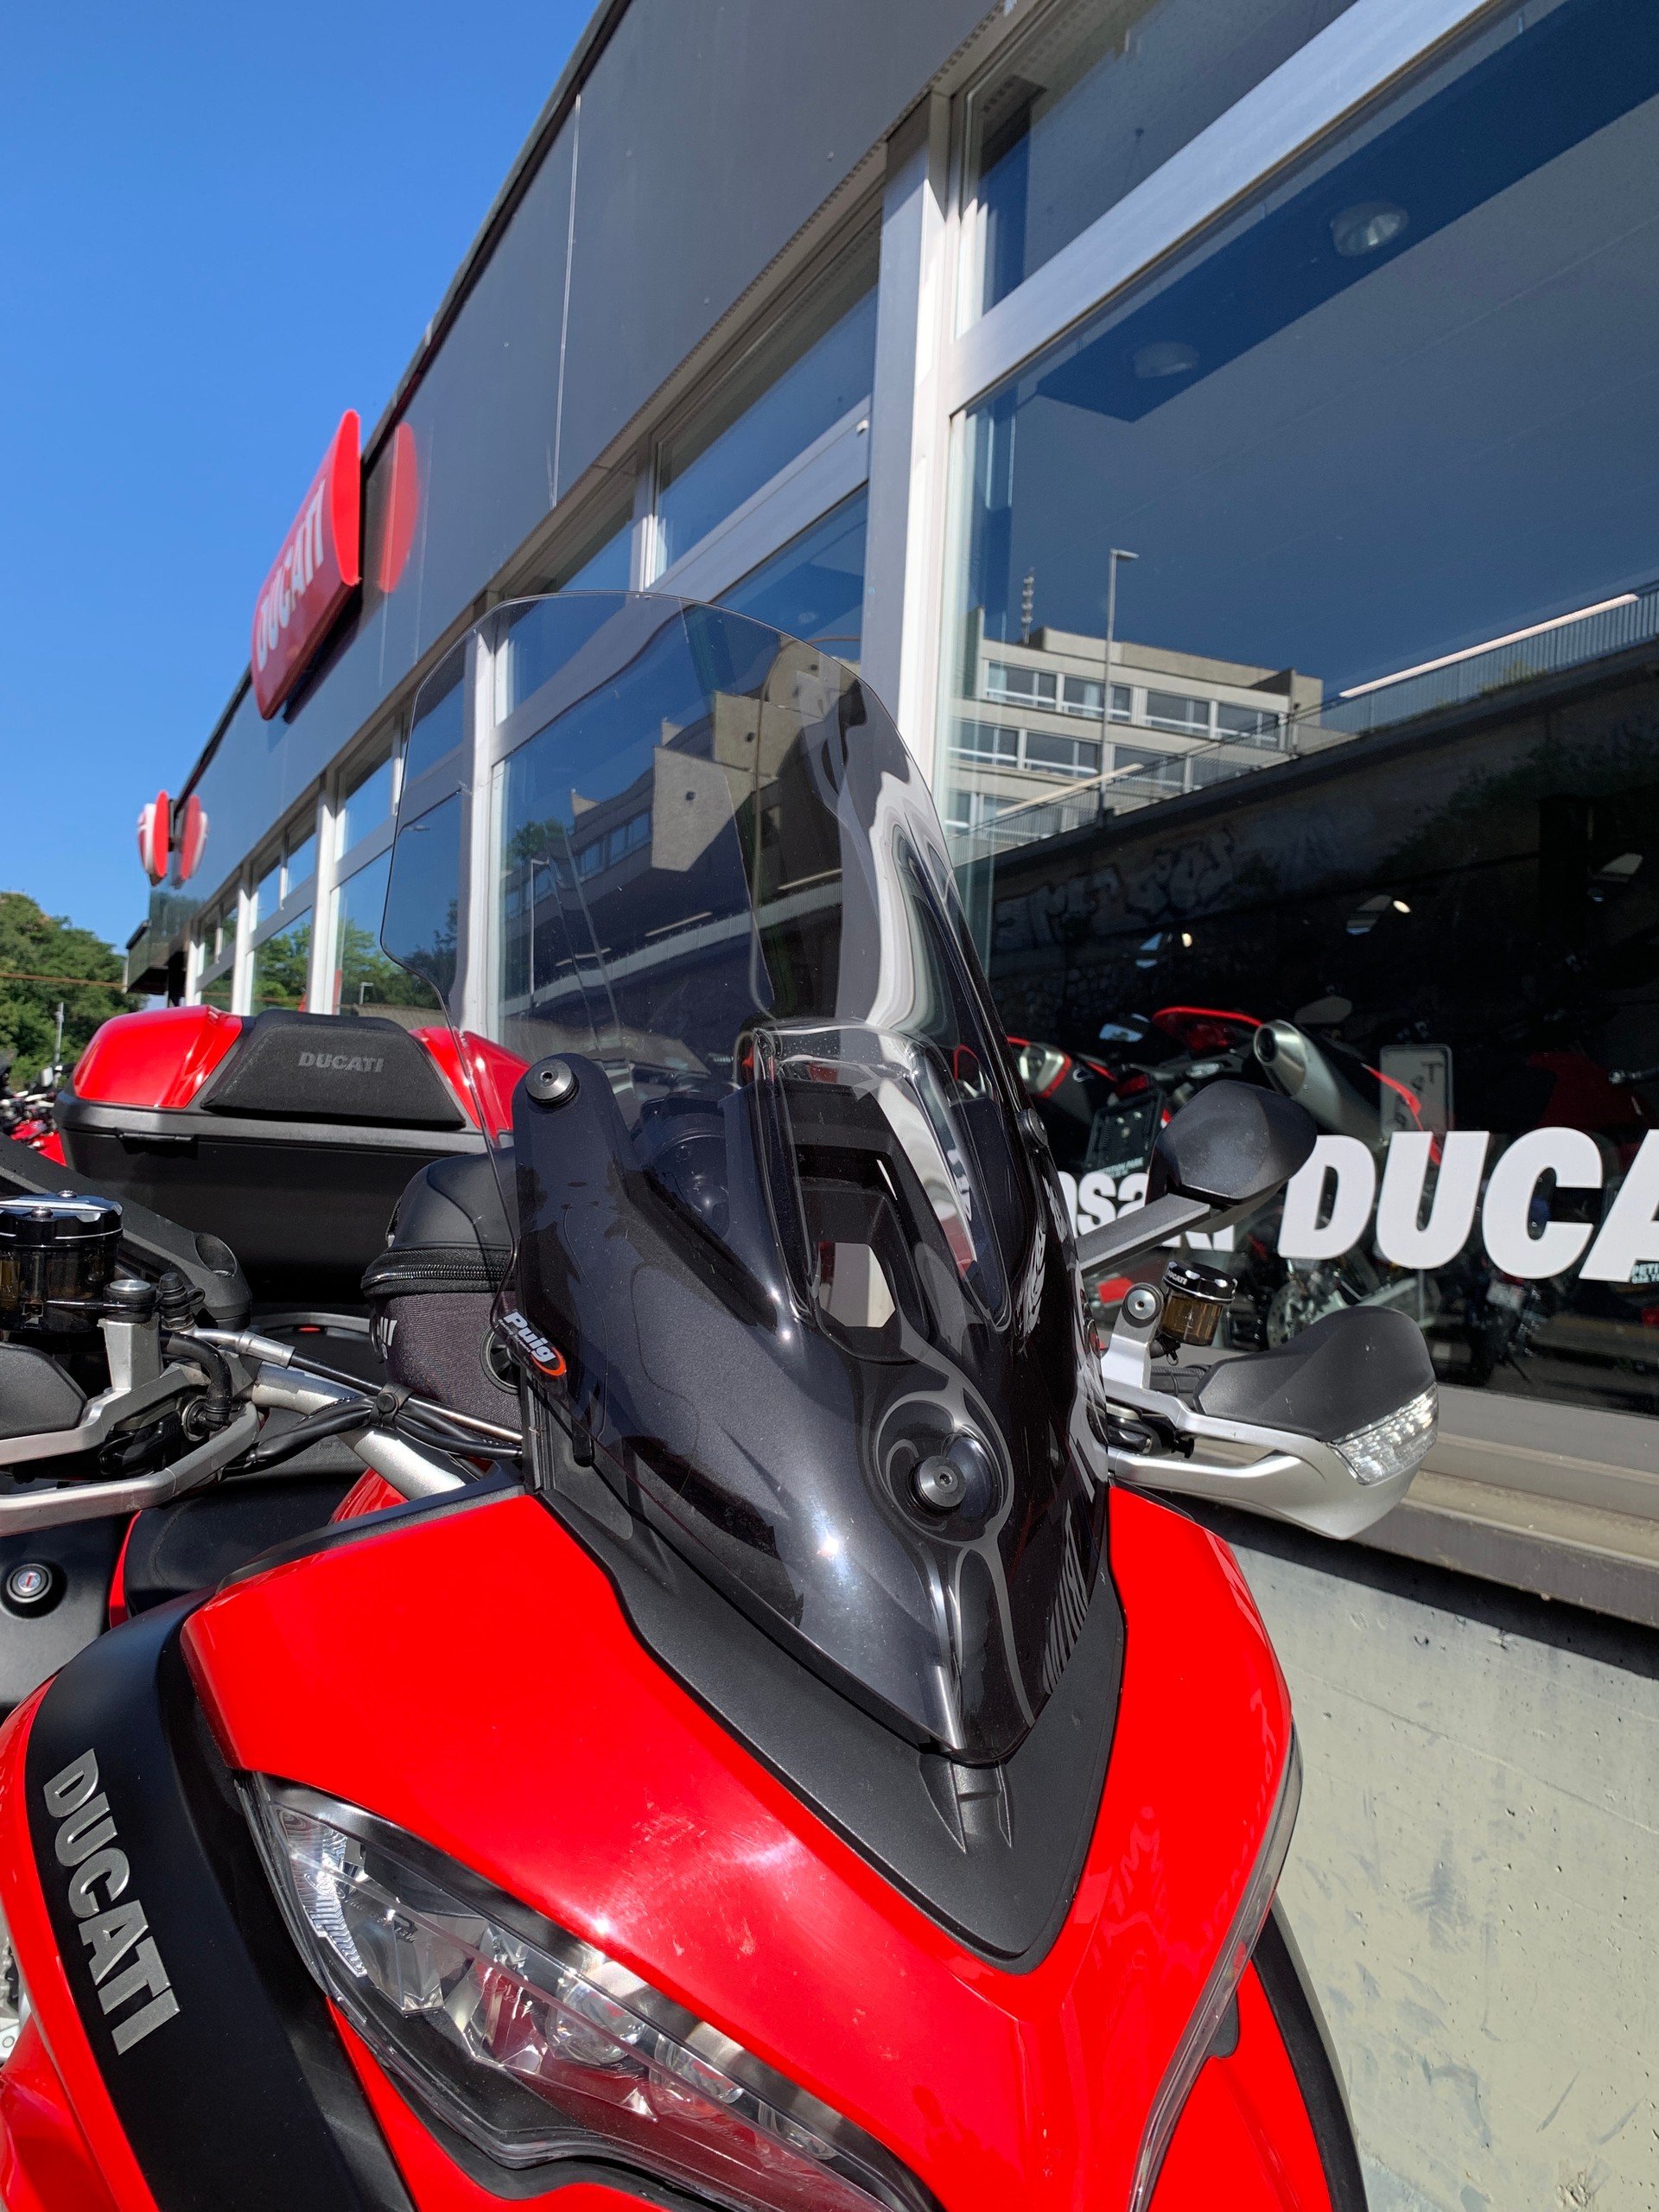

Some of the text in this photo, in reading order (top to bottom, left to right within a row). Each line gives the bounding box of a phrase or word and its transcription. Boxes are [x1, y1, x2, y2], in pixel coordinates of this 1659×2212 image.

[257, 478, 326, 672] DUCATI
[298, 1051, 385, 1073] DUCATI
[503, 1311, 556, 1363] Puig
[43, 1748, 181, 2056] DUCATI
